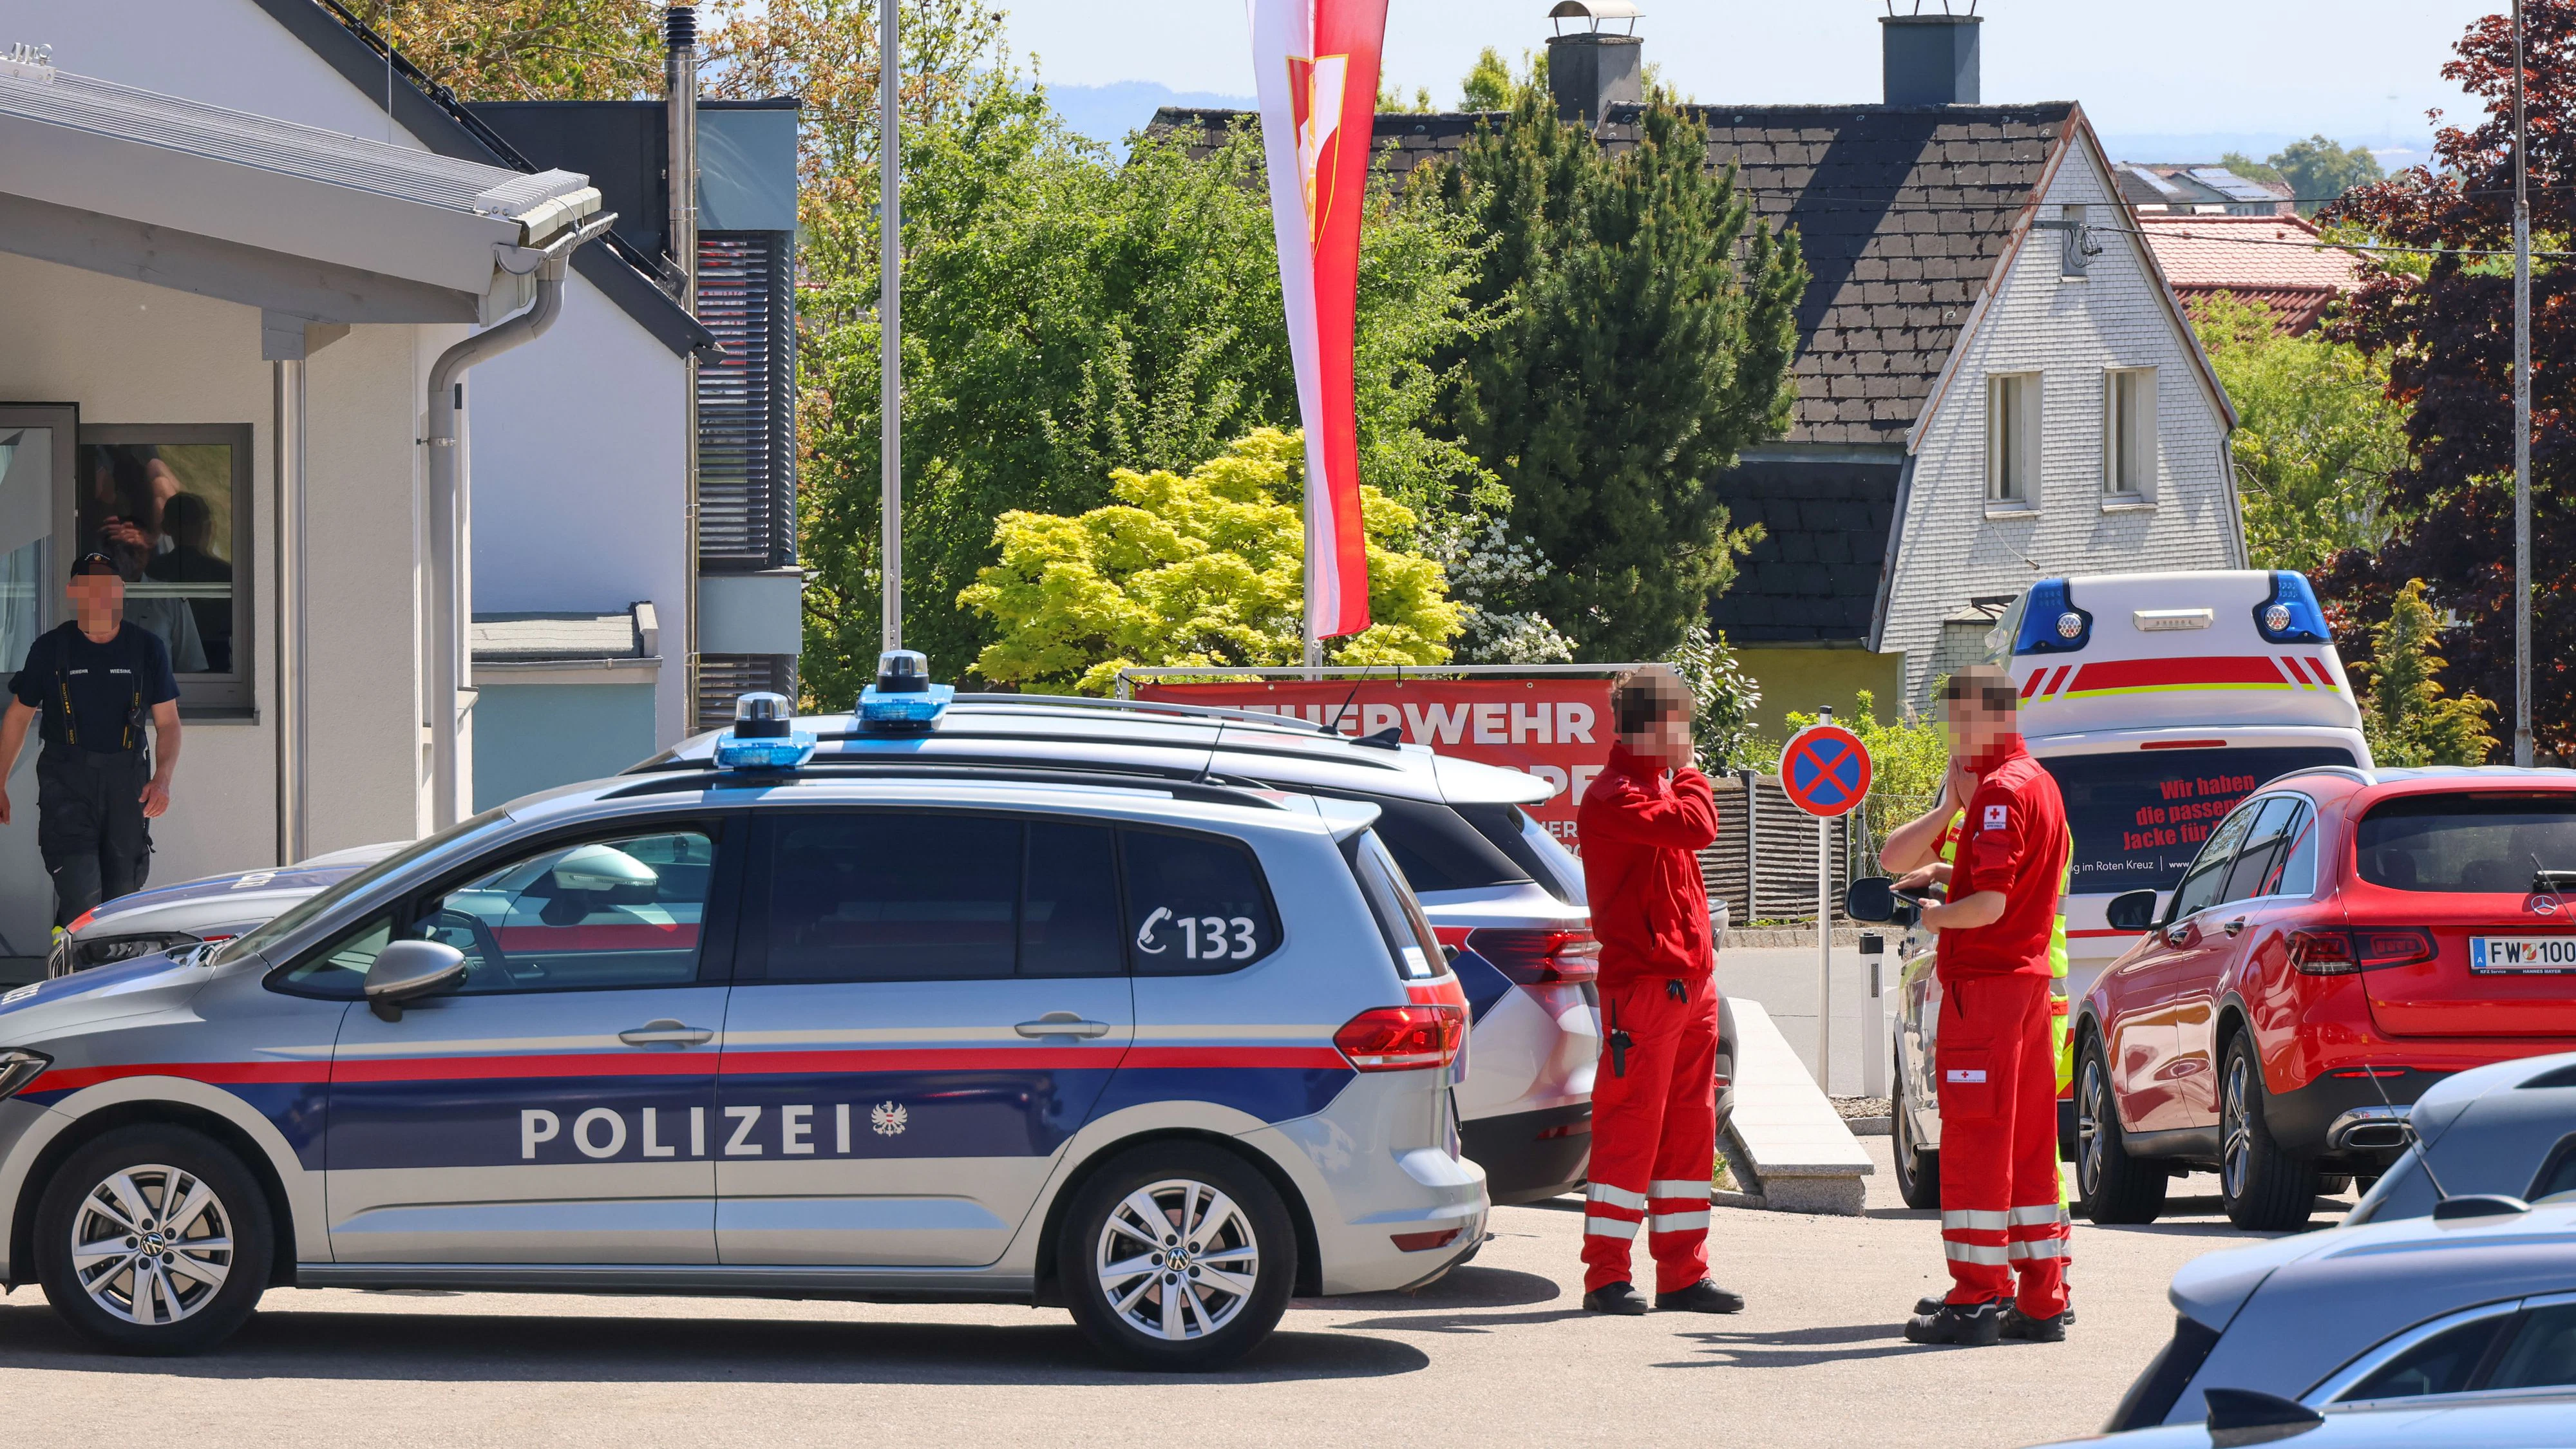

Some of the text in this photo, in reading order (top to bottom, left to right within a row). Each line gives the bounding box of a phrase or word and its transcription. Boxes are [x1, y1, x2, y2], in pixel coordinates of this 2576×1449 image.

[2160, 775, 2255, 799] Wir haben
[2136, 806, 2165, 826] die
[2123, 828, 2177, 850] Jacke
[2180, 823, 2208, 843] für
[2082, 863, 2094, 872] im
[2096, 861, 2124, 871] Roten
[2126, 860, 2154, 869] Kreuz
[1177, 916, 1256, 960] 133
[2491, 942, 2576, 963] FW 100
[521, 1104, 851, 1159] POLIZEI
